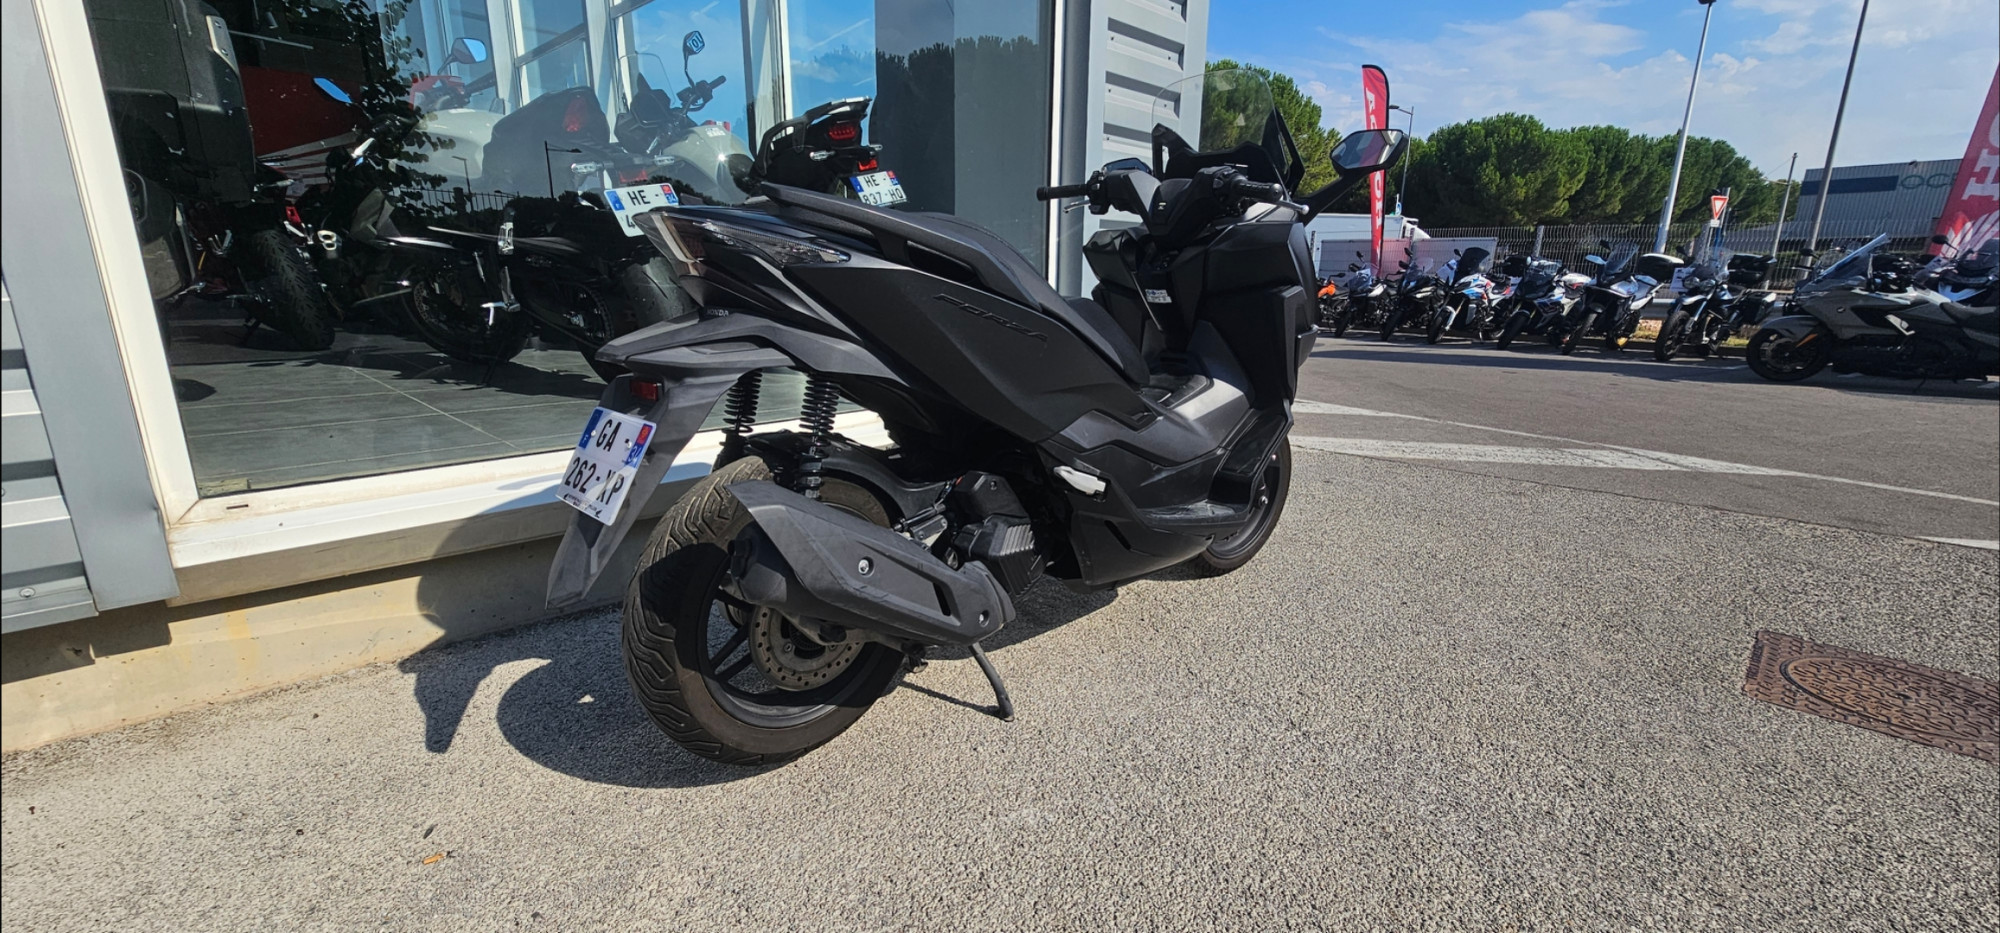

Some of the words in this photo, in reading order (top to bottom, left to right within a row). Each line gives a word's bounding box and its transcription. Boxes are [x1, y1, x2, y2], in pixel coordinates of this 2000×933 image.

[1901, 173, 1958, 189] OC
[627, 190, 651, 206] HE
[932, 293, 1048, 342] FORZA
[596, 419, 622, 452] GA
